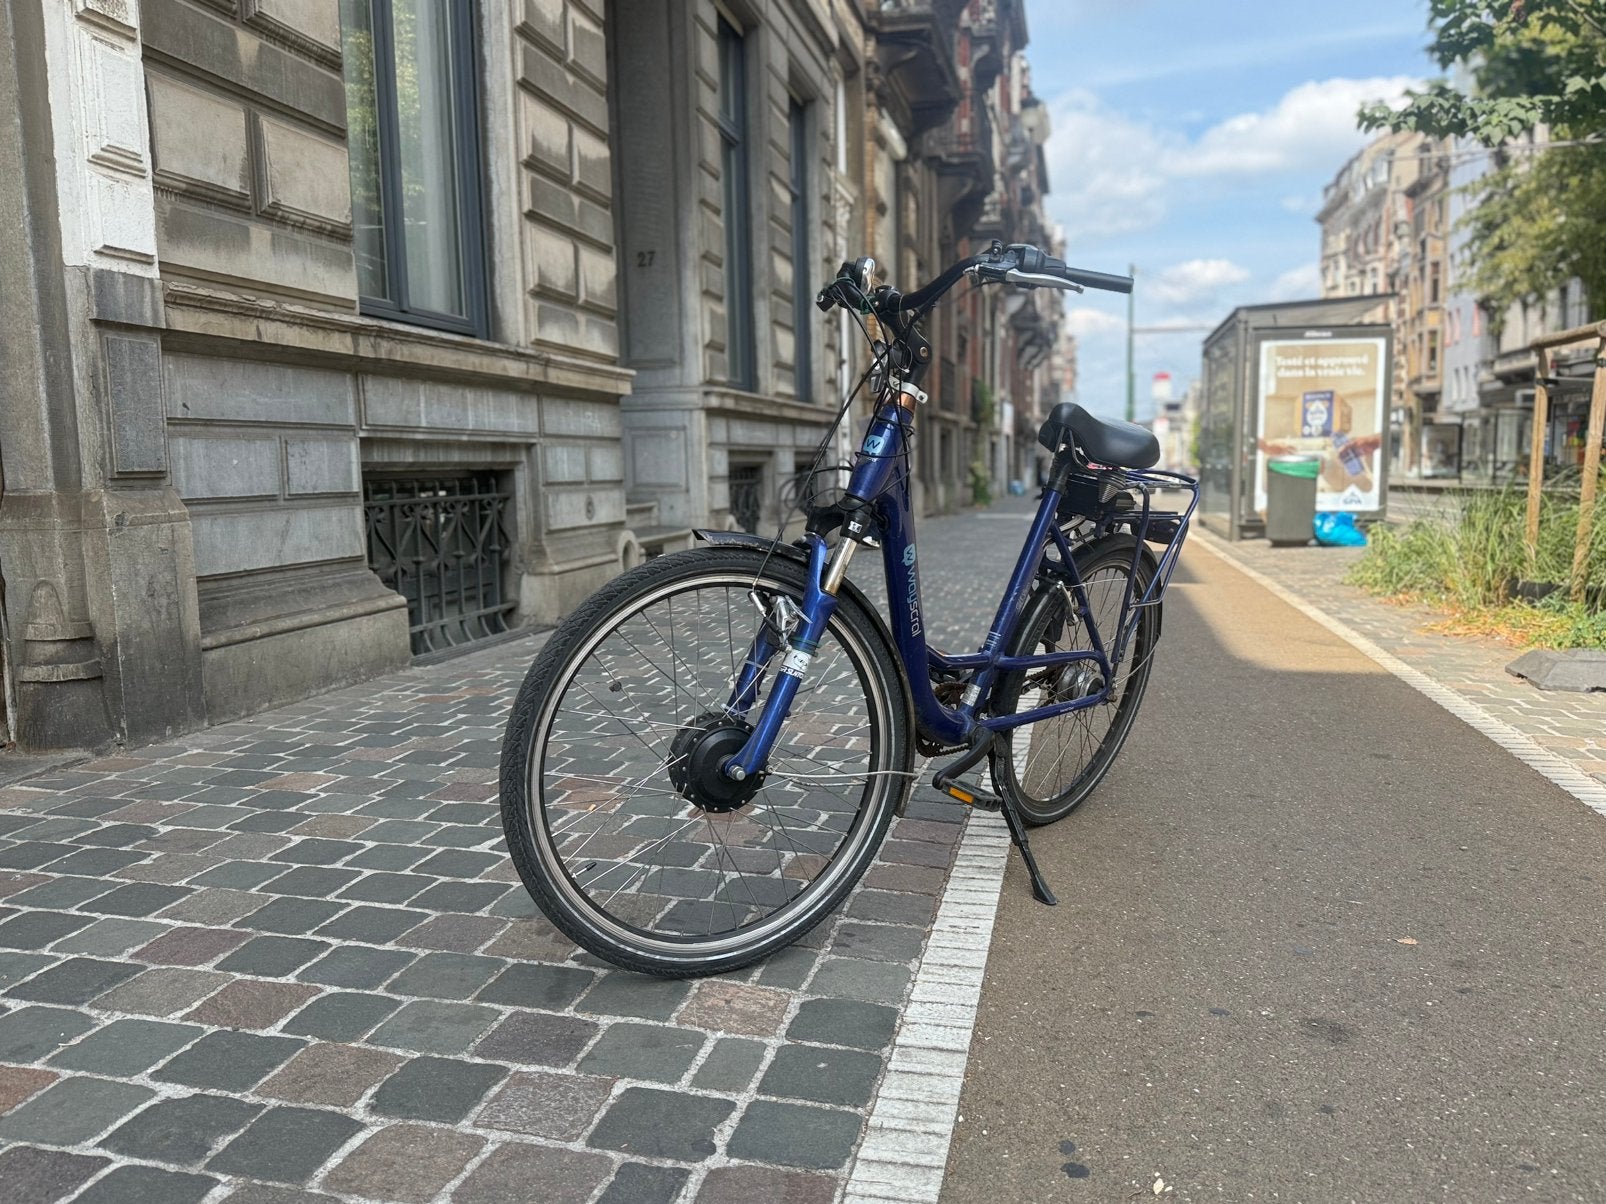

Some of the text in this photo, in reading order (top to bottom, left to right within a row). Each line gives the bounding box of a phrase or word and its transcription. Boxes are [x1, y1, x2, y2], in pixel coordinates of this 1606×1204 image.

[637, 250, 656, 268] 27
[1304, 357, 1317, 366] et
[906, 564, 921, 638] wayscral
